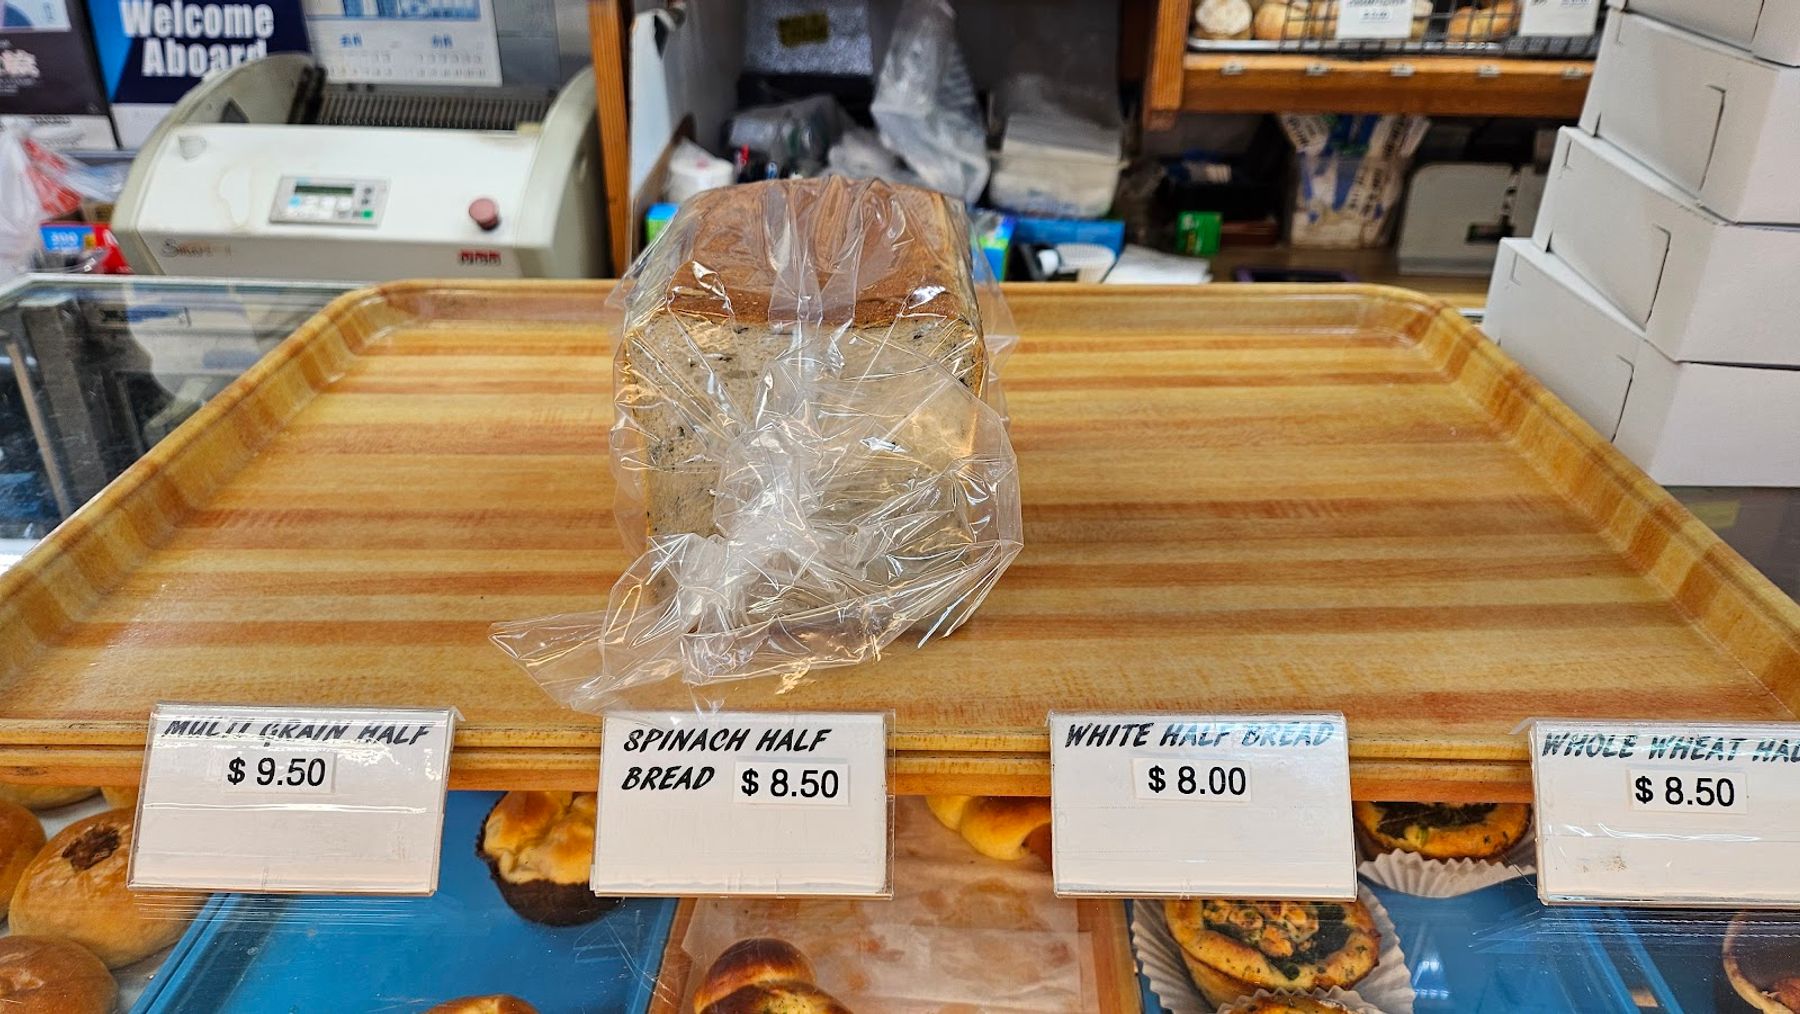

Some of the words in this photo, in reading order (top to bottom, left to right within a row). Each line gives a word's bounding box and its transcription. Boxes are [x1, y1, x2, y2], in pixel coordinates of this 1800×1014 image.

[119, 0, 275, 39] Welcome
[258, 720, 351, 747] GRAIN
[355, 723, 432, 746] HALF
[622, 727, 751, 752] SPINACH
[754, 727, 833, 752] HALF
[1064, 721, 1155, 748] WHITE
[1158, 720, 1232, 748] HALF
[1241, 720, 1336, 747] BREAD
[1541, 732, 1638, 758] WHOLE
[1649, 733, 1748, 761] WHEAT
[621, 764, 716, 791] BREAD
